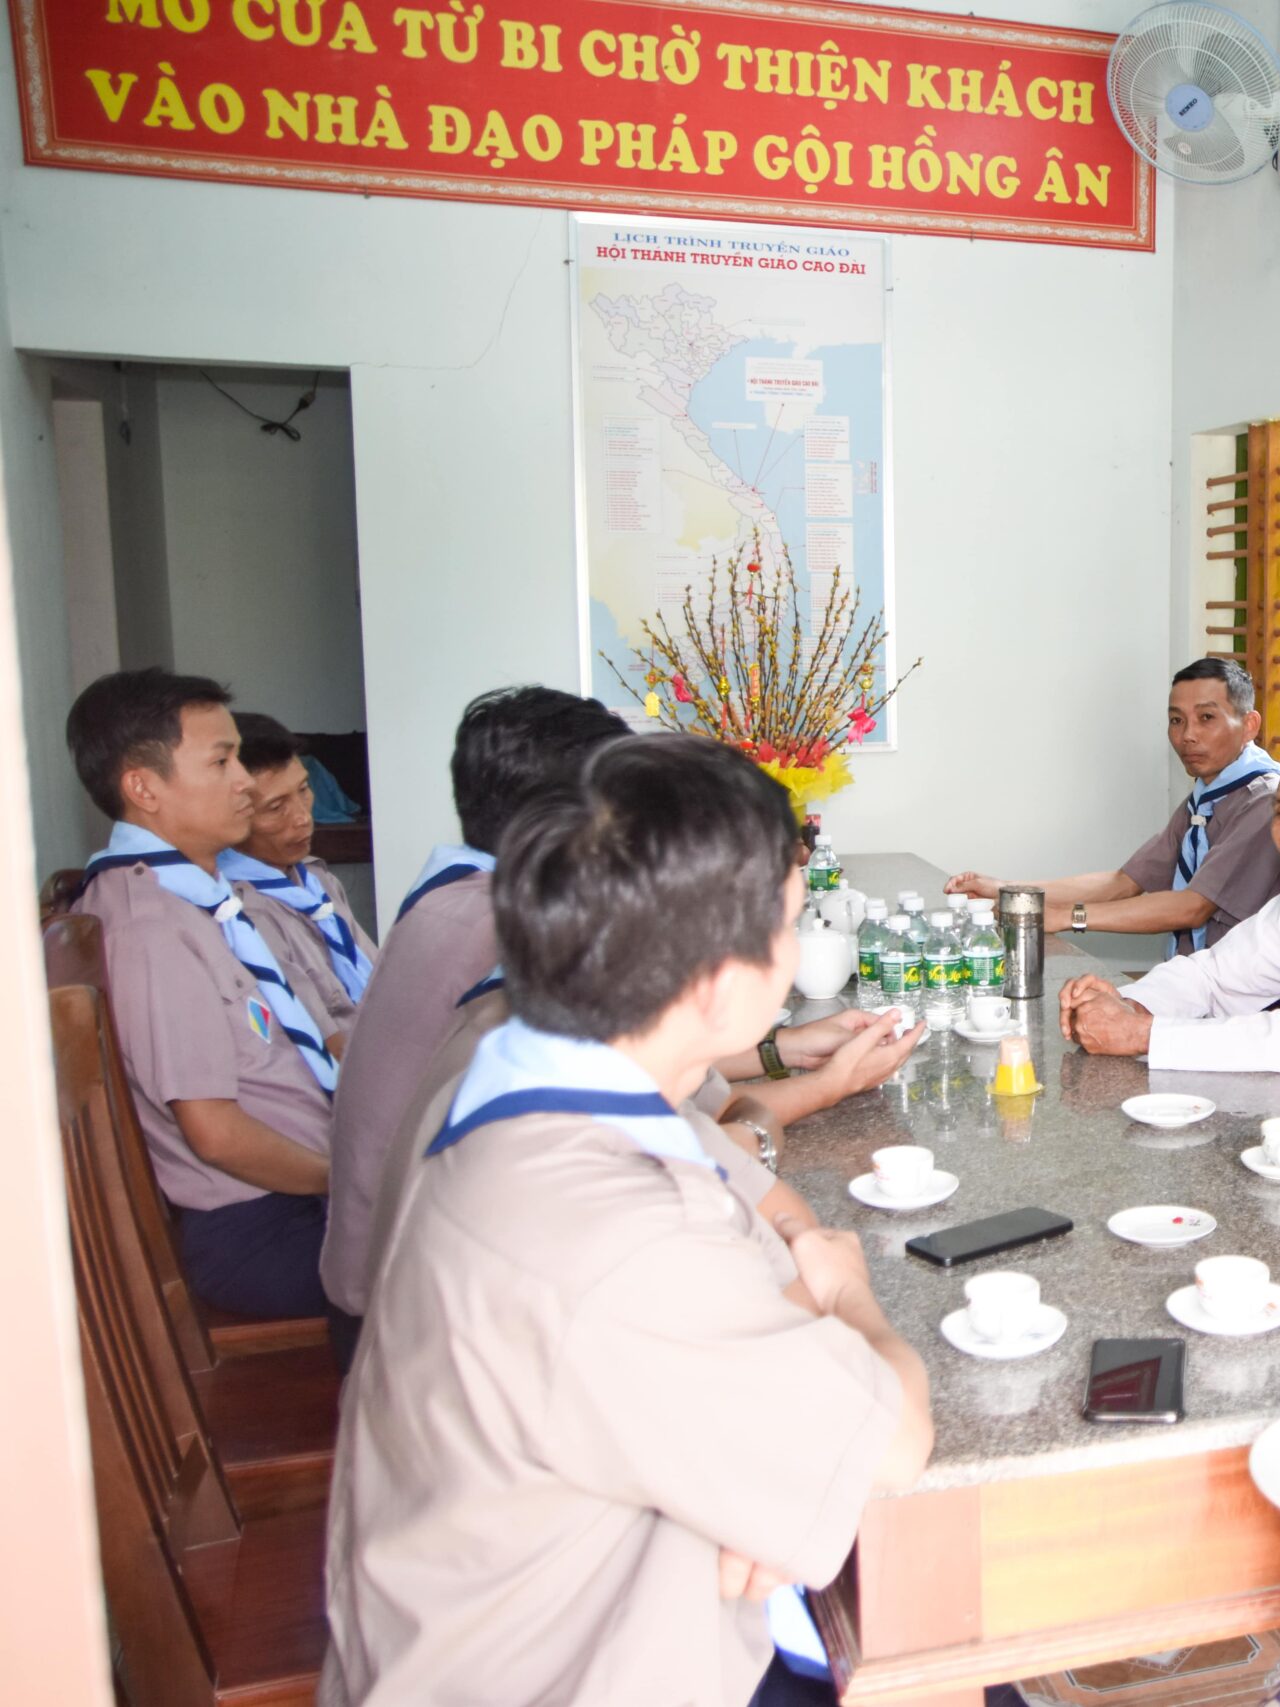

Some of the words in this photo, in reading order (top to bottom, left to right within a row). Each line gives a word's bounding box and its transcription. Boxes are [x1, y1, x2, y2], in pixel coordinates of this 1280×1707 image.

[393, 0, 485, 63] TỪ
[499, 20, 563, 73] BI
[579, 24, 702, 85] CHỜ
[717, 40, 892, 110] THIỆN
[907, 60, 1095, 125] KHÁCH
[86, 63, 245, 134] VÀO
[263, 85, 409, 150] NHÀ
[428, 105, 564, 169] ĐẠO
[578, 113, 738, 176] PHÁP
[754, 124, 854, 194] GỘI
[869, 125, 1021, 199] HỒNG
[1034, 147, 1112, 208] ÂN
[596, 244, 627, 261] HỘI
[630, 246, 686, 263] THÁNH
[757, 254, 798, 270] GIÁO
[802, 260, 835, 273] CAO
[839, 259, 866, 275] ĐÀI
[613, 232, 658, 243] LỊCH
[664, 235, 722, 248] TRÌNH
[806, 244, 850, 257] GIÁO
